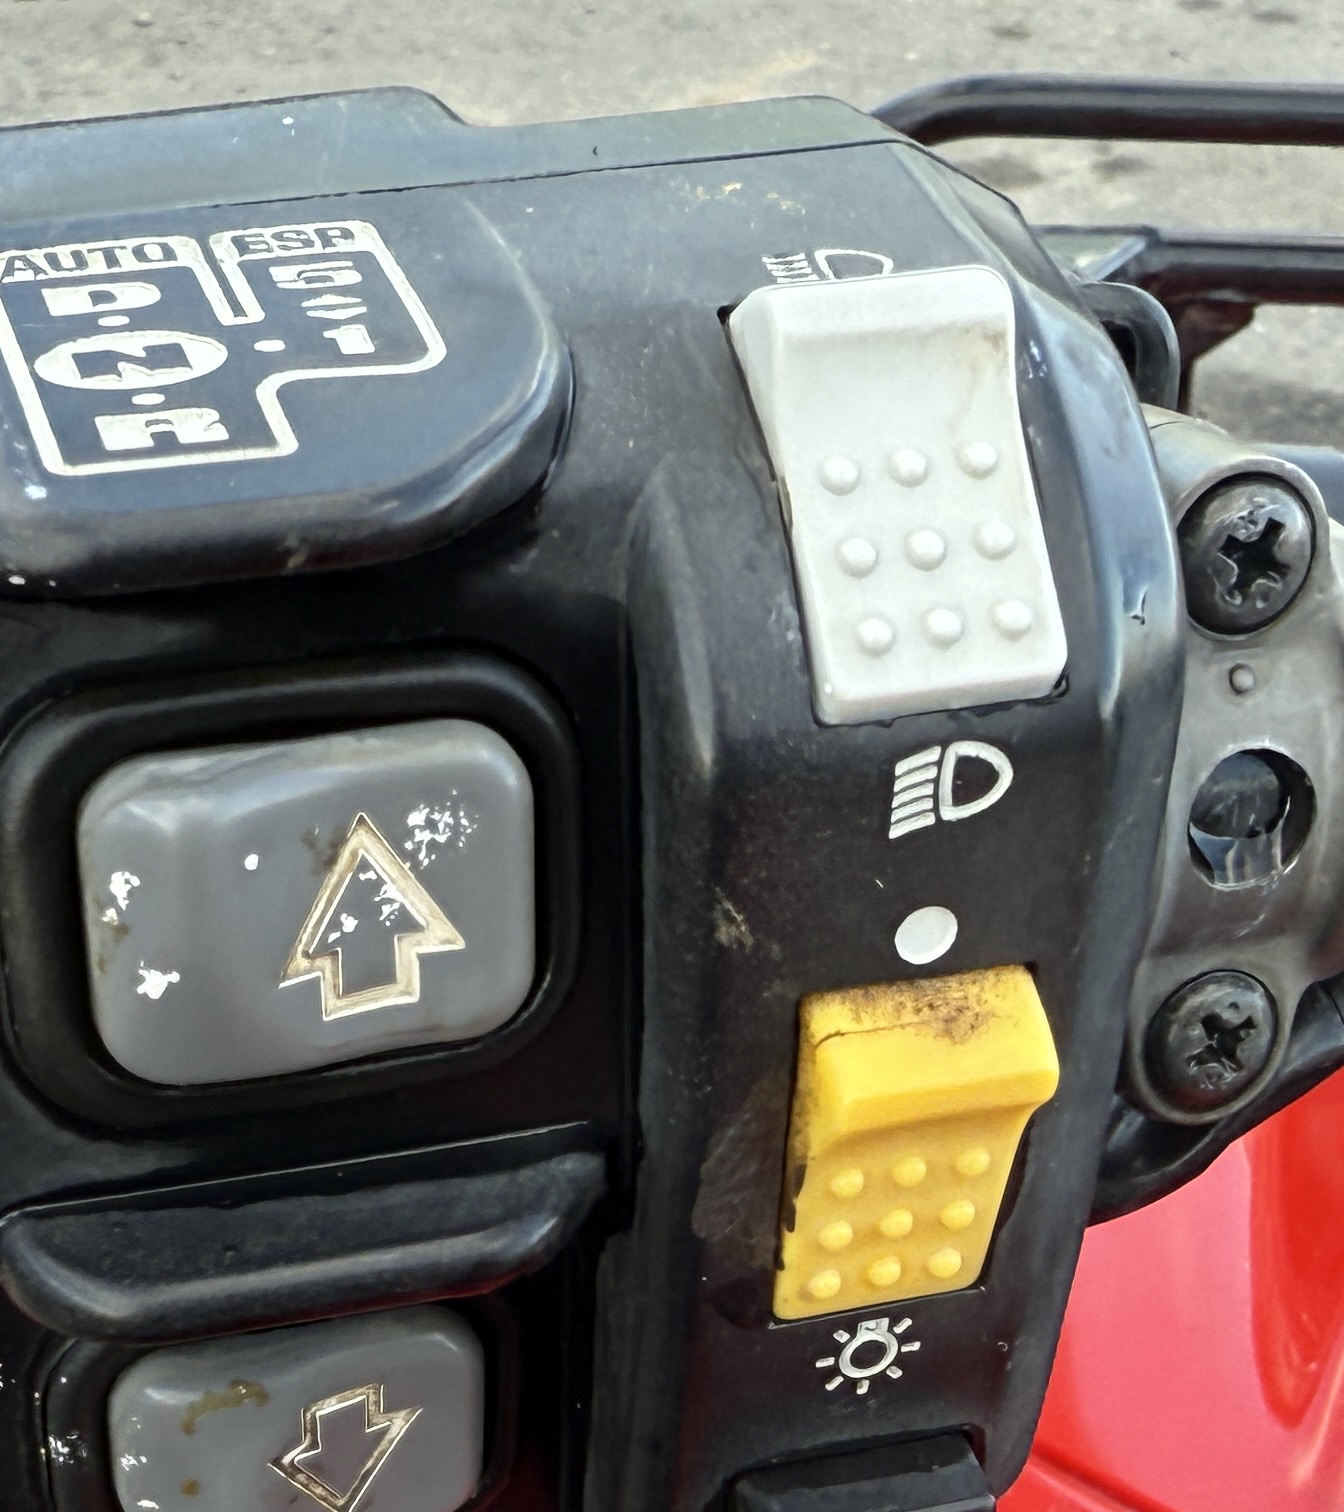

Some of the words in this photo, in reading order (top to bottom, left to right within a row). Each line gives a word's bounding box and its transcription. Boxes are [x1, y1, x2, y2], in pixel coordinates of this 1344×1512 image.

[230, 227, 356, 257] ESP
[0, 242, 178, 284] AUTO
[41, 282, 162, 317] D
[323, 324, 375, 355] 1
[71, 343, 193, 382] N
[94, 408, 230, 451] R
